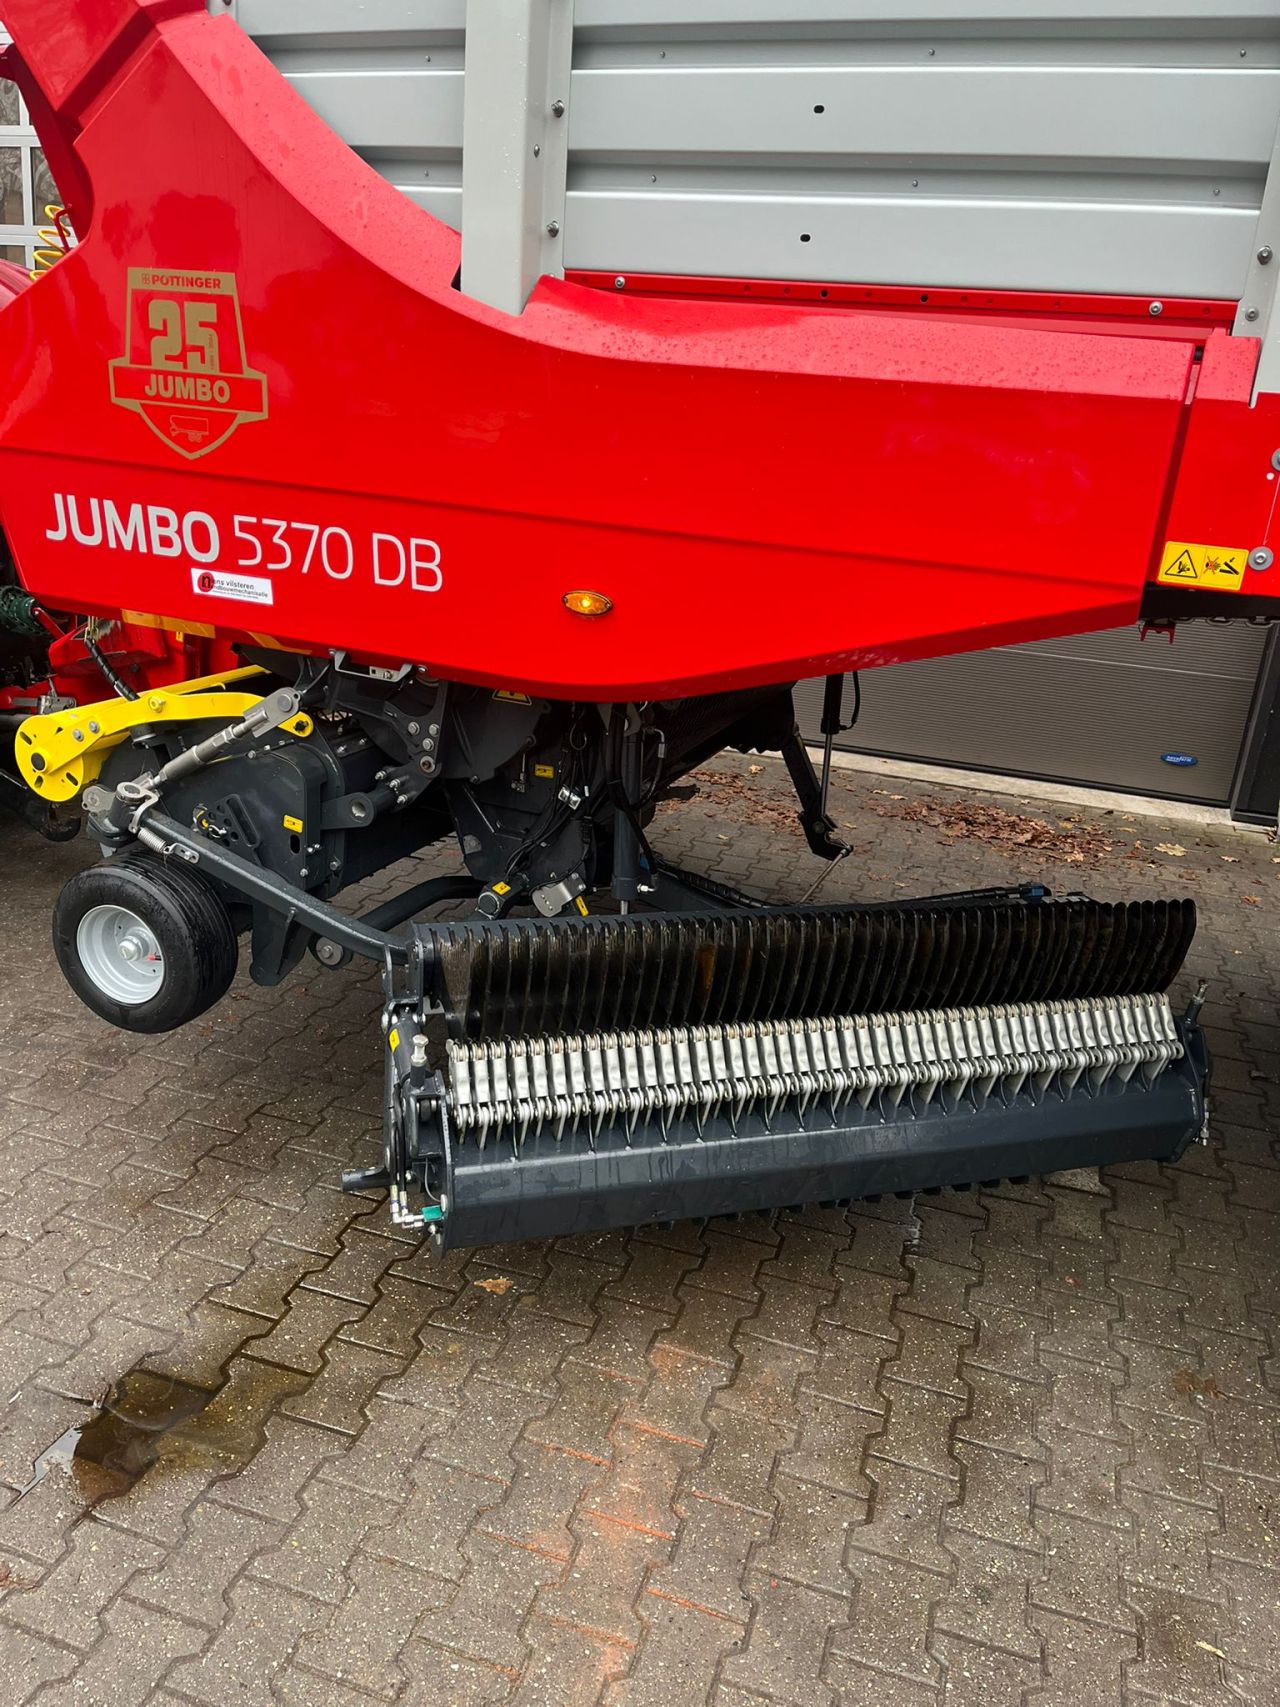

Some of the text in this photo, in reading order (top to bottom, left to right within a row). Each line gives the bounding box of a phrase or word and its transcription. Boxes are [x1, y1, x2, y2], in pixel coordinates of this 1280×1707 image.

[148, 299, 220, 374] 25
[144, 373, 231, 404] JUMBO
[46, 493, 443, 593] JUMBO 5370 DB
